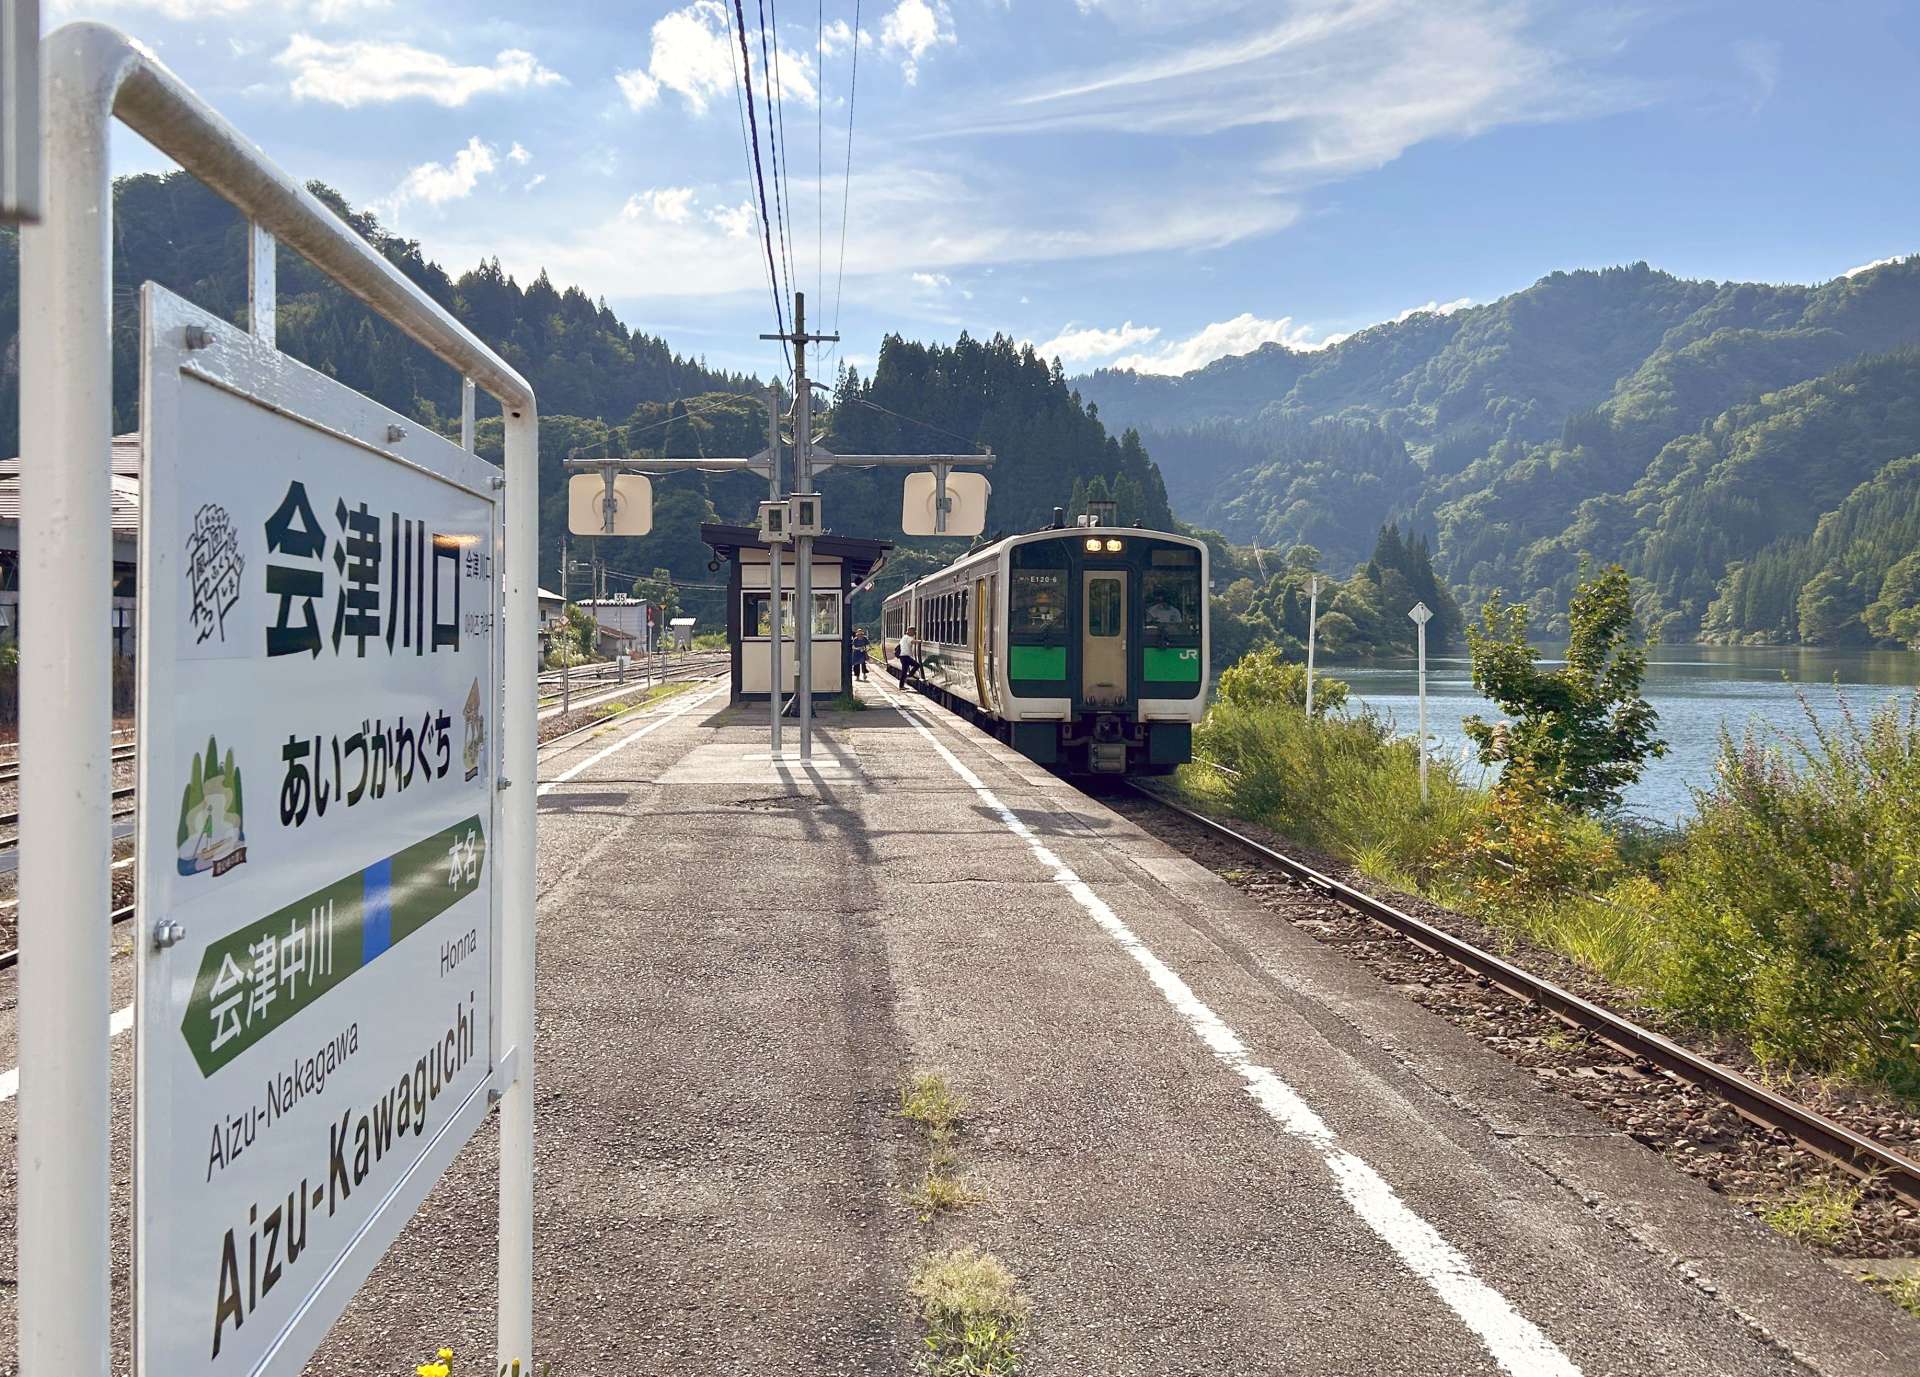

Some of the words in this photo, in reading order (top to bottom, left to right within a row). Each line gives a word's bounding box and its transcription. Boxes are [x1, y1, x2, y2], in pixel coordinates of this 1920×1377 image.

[264, 480, 461, 659] 会津川口
[1179, 649, 1198, 660] JR
[280, 709, 451, 827] あいづかわぐち
[449, 827, 476, 892] 本名
[209, 898, 334, 1053] 会津中川
[440, 928, 477, 978] Honna
[207, 1021, 359, 1183] Aizu-Nakagawa
[212, 991, 475, 1361] Aizu-Kawaguchi
